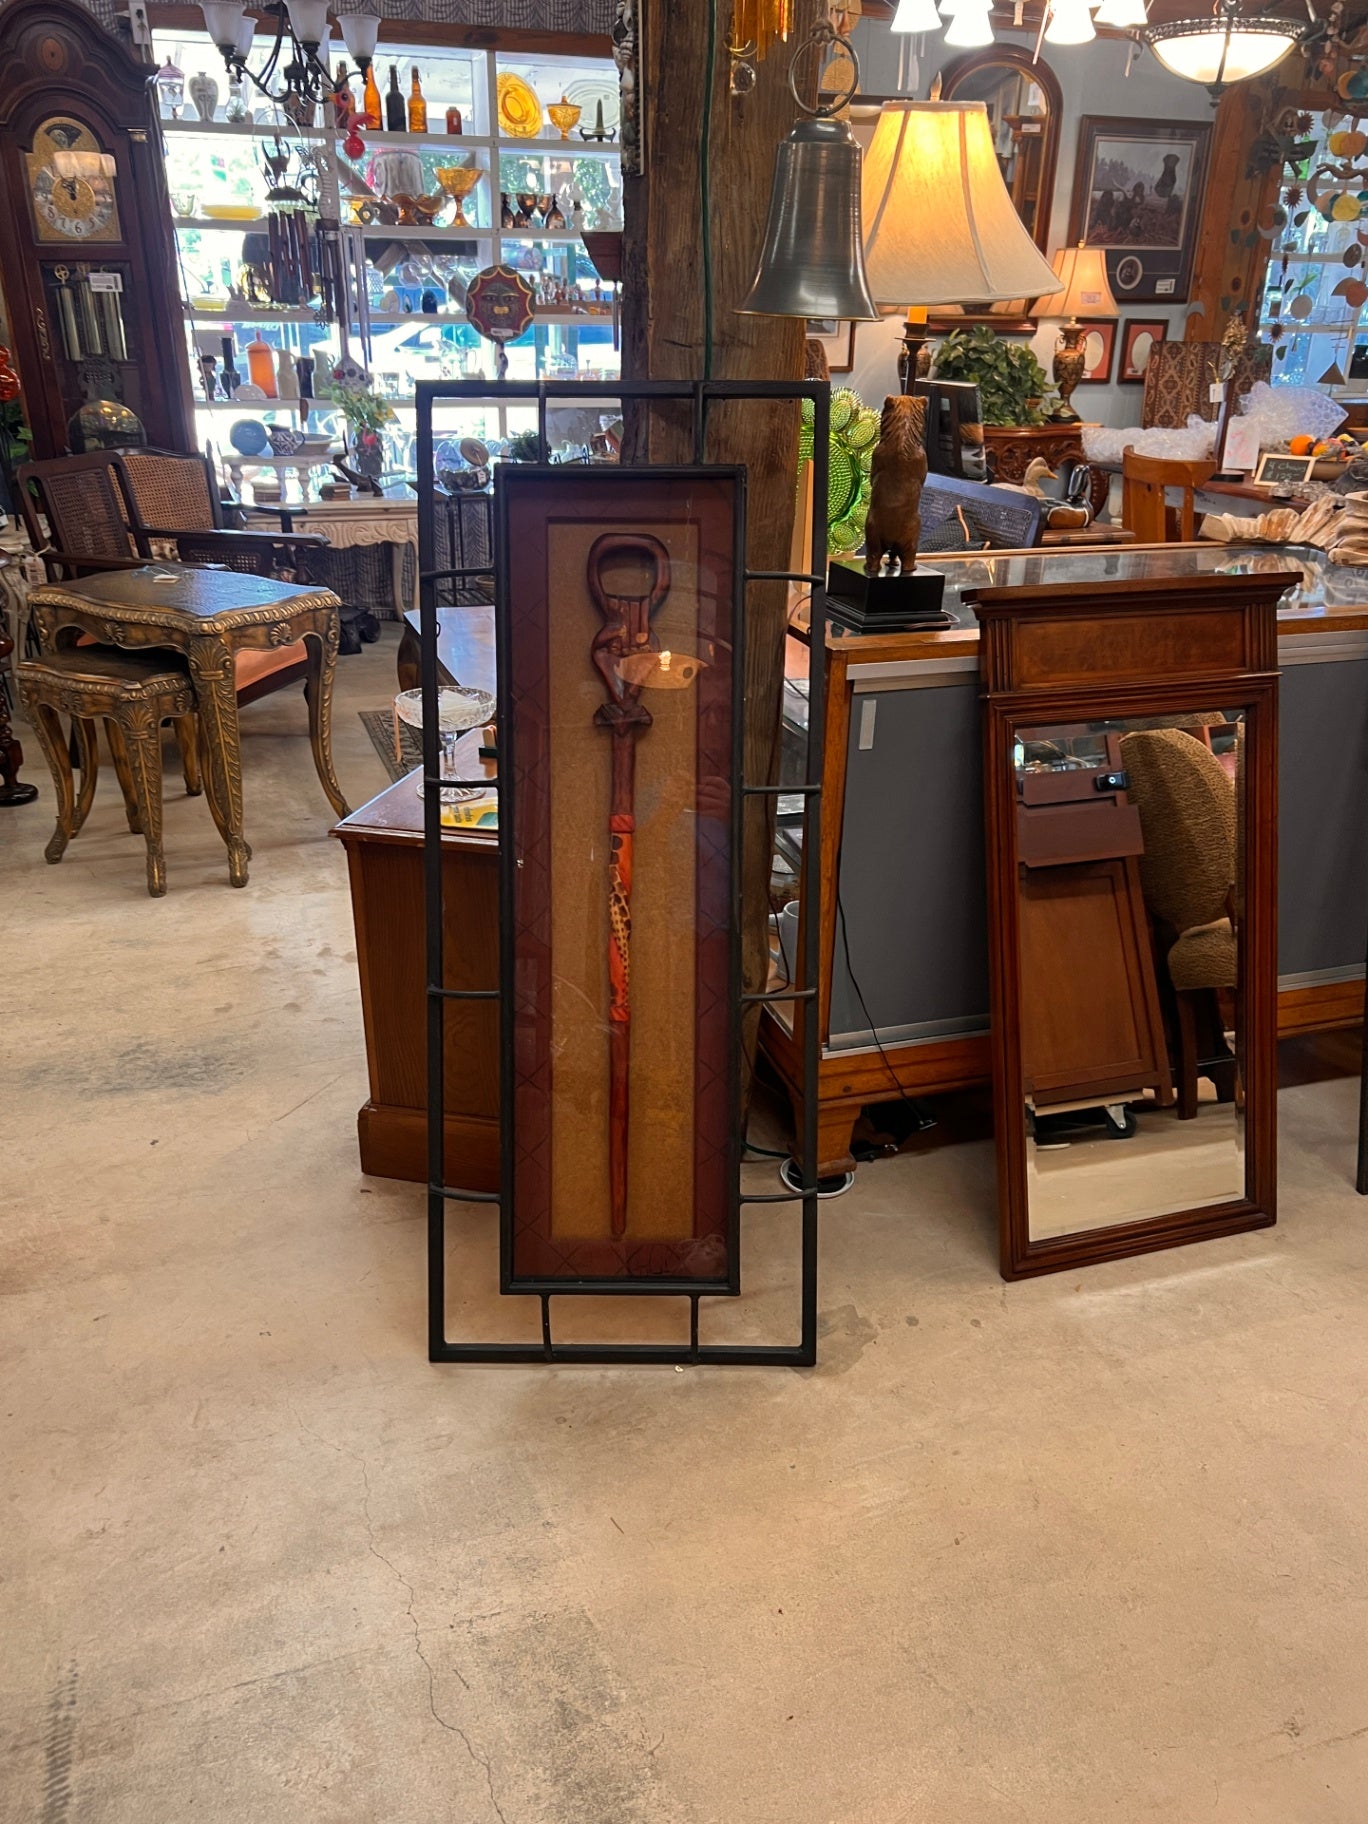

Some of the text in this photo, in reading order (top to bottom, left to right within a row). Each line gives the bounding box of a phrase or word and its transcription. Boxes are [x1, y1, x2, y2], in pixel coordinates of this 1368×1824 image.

[47, 206, 55, 219] 8
[60, 217, 66, 229] 7
[75, 221, 82, 234] 6
[89, 217, 95, 229] 5
